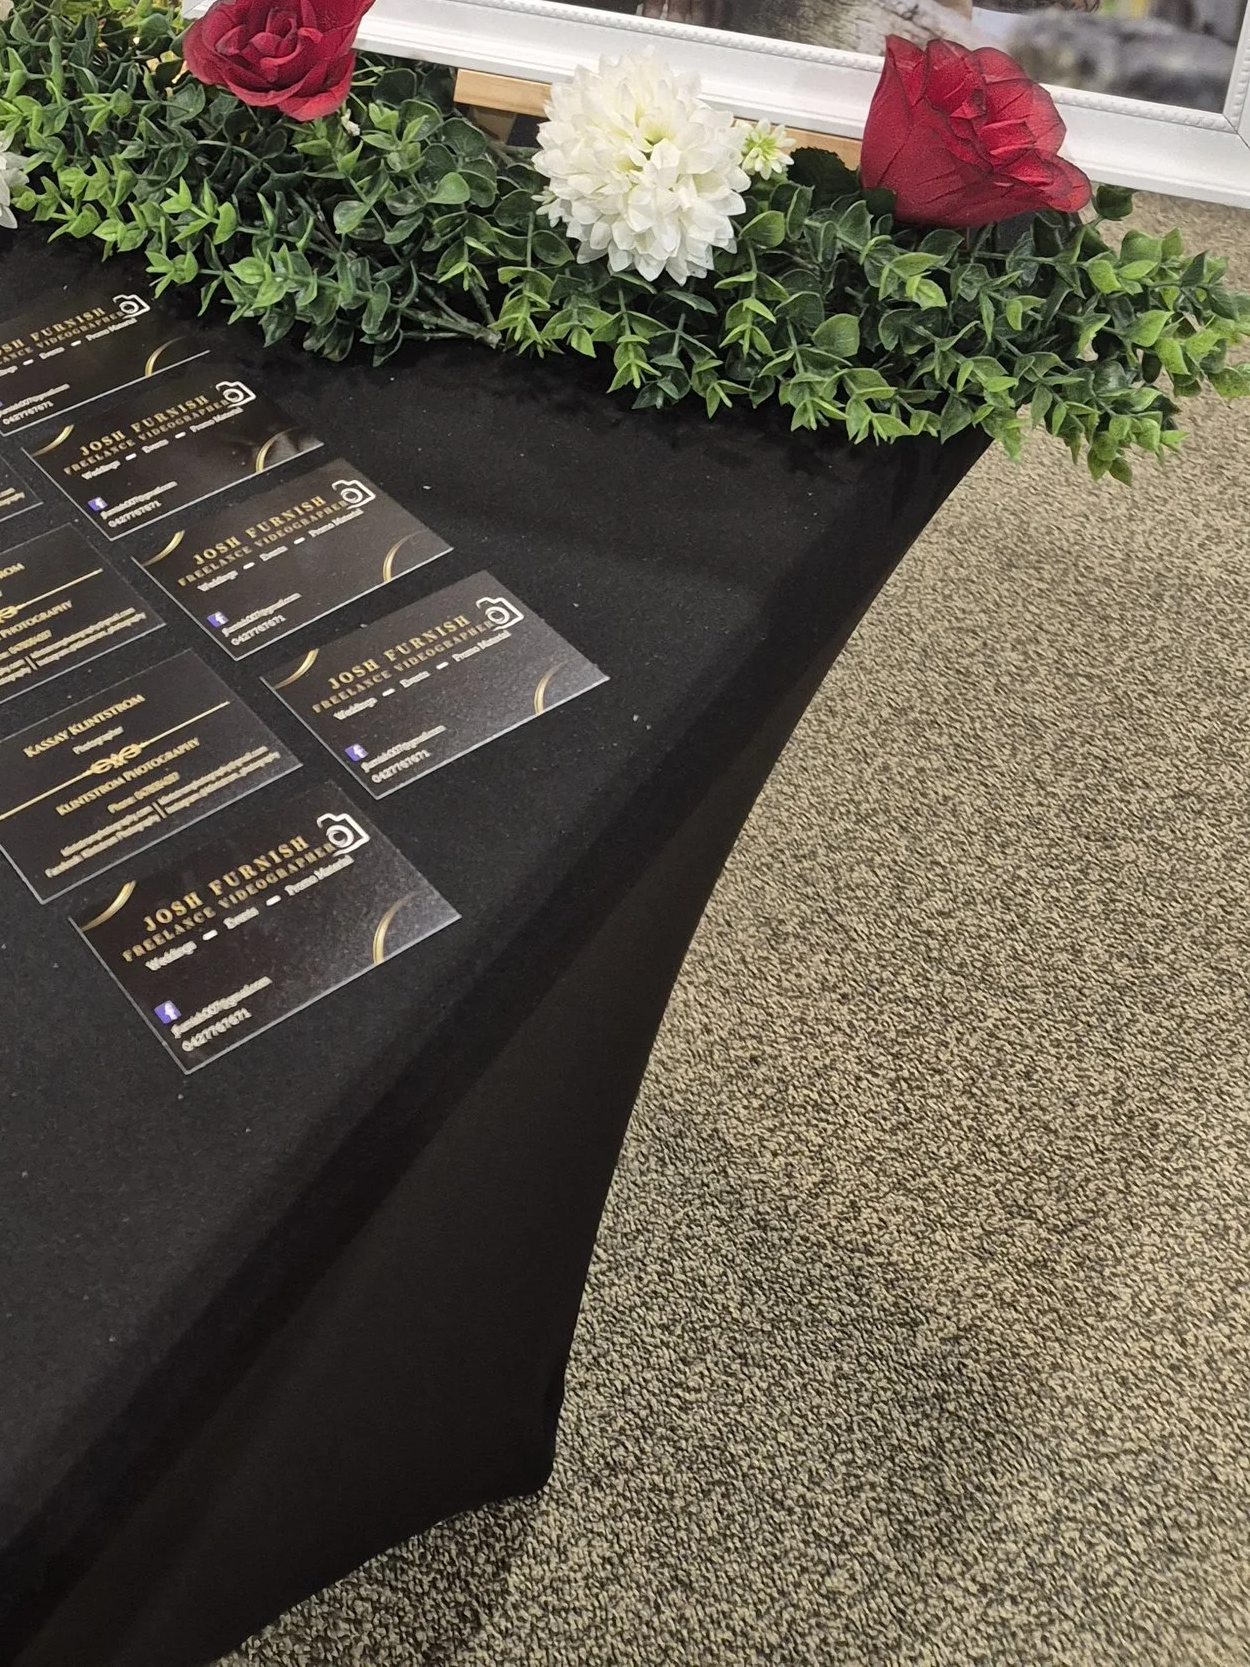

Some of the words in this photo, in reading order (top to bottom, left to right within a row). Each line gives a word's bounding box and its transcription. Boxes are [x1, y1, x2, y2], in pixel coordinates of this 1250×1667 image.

[30, 307, 106, 342] FURNISH
[38, 311, 125, 349] VIDEOGRAPHER
[63, 438, 136, 476] FREELANCE
[138, 398, 230, 442] VIDEOGRAPHER
[79, 429, 125, 457] JOSH
[131, 394, 209, 433] FURNISH
[177, 545, 252, 587] FREELANCE
[254, 499, 348, 548] VIDEOGRAPHER
[193, 536, 242, 566] JOSH
[245, 495, 326, 539] FURNISH
[0, 600, 73, 639] PHOTOGRAPHY
[328, 658, 381, 691] JOSH
[383, 614, 471, 662] FURNISH
[312, 669, 392, 714] FREELANCE
[393, 620, 494, 673] VIDEOGRAPHER
[23, 730, 70, 758] KASSAY
[68, 694, 146, 735] KLINTSTROM
[55, 773, 127, 816] KLINTSTROM
[124, 737, 200, 782] PHOTOGRAPHY
[122, 905, 217, 963] FREELANCE
[218, 841, 336, 911] VIDEOGRAPHER
[144, 891, 204, 932] JOSH
[207, 834, 310, 897] FURNISH
